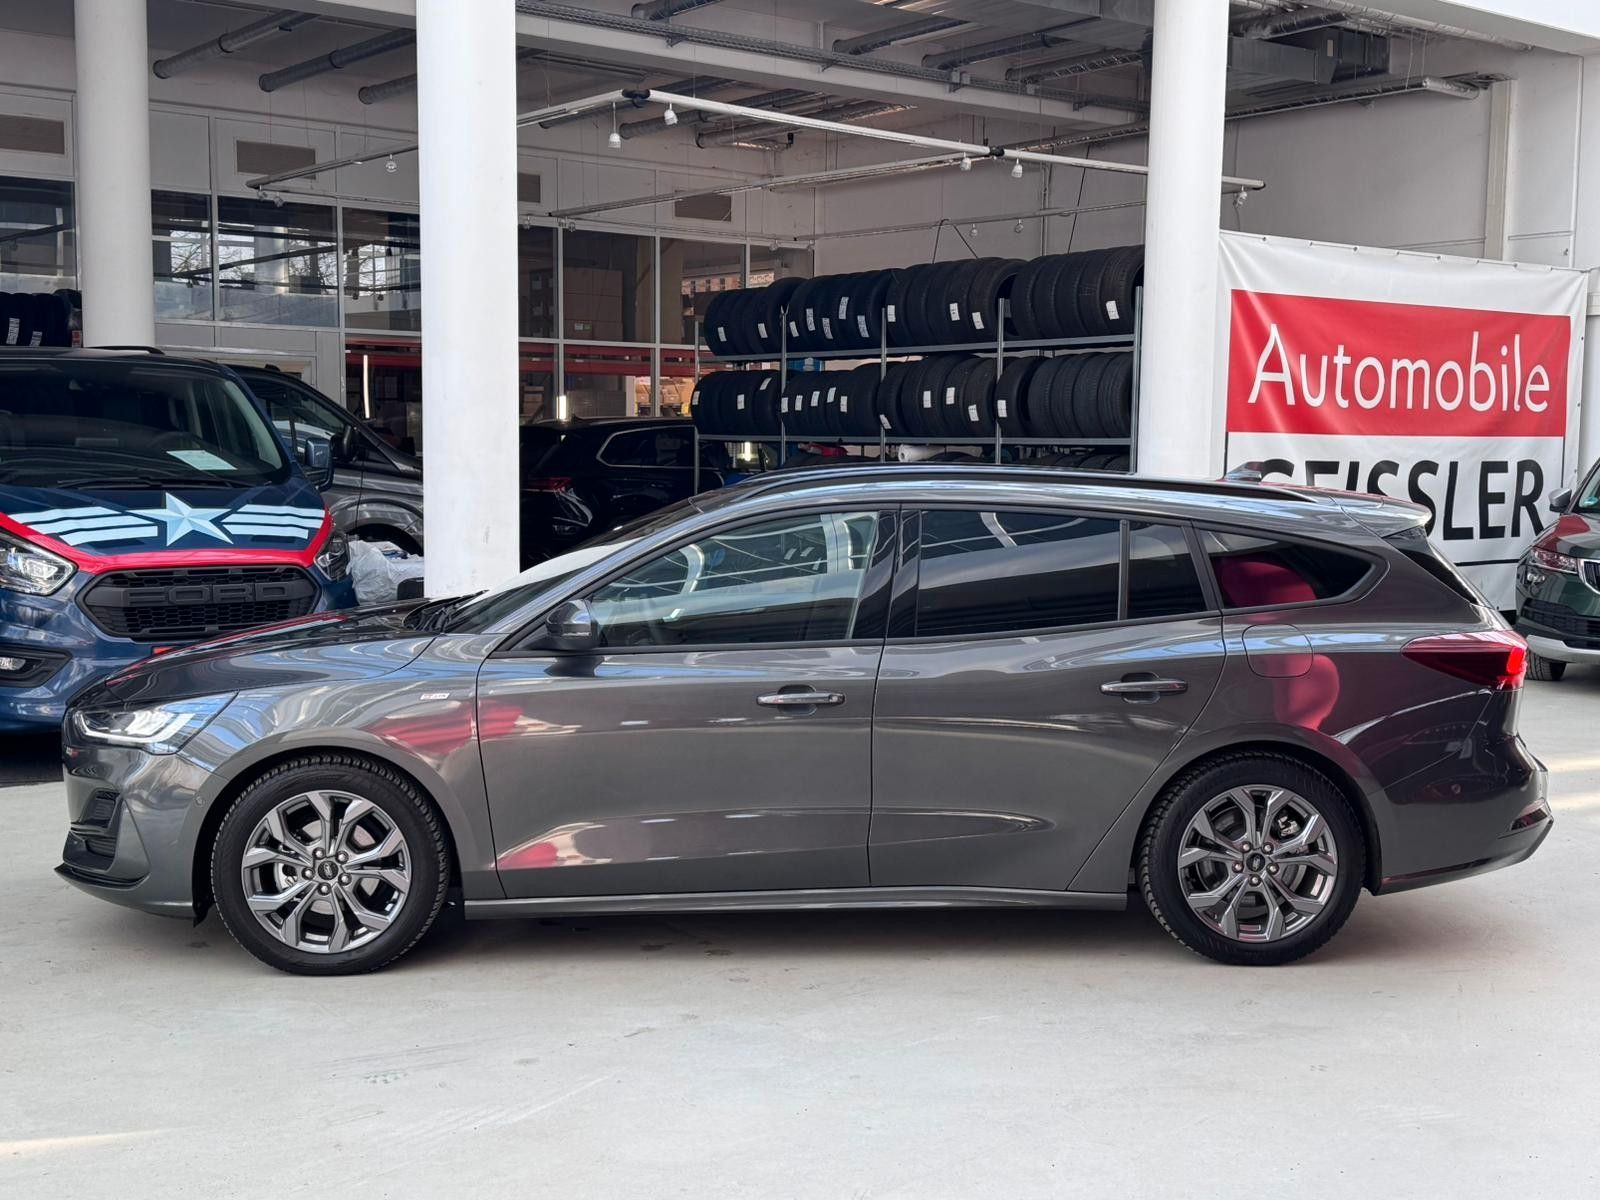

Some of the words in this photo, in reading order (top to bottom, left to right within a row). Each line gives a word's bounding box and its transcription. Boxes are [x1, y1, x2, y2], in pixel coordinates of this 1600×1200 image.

[1247, 323, 1550, 412] Automobile
[1261, 458, 1544, 541] SLER
[123, 582, 294, 607] FORD
